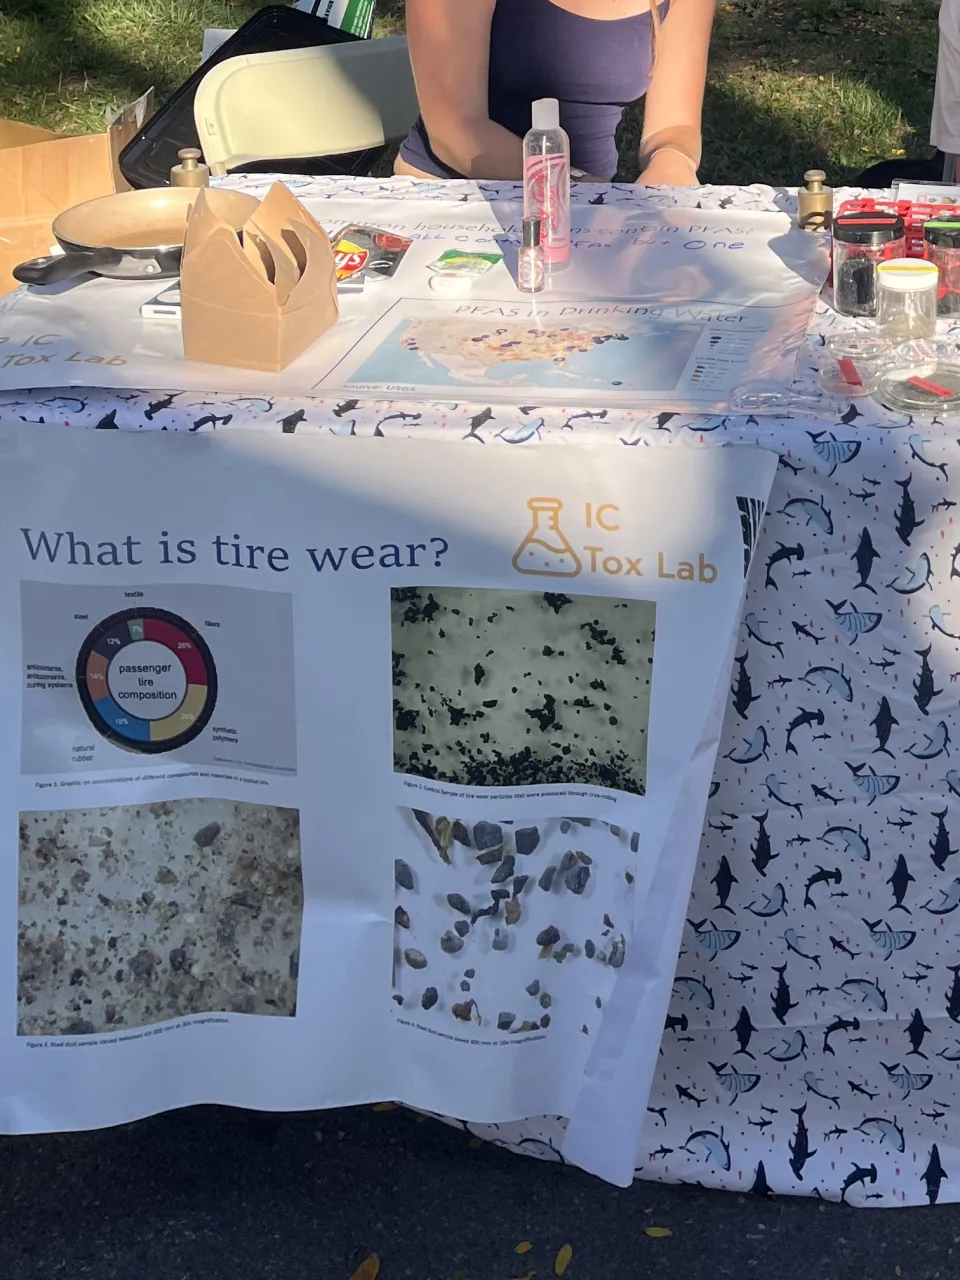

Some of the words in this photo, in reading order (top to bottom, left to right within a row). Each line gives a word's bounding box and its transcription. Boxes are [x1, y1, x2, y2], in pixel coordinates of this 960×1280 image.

[323, 0, 335, 20] AVIOR
[317, 217, 407, 233] ommon
[454, 235, 523, 246] Conta
[455, 305, 520, 317] PFAS
[527, 307, 549, 318] in
[558, 305, 664, 319] Drinking
[675, 307, 749, 322] Water
[20, 333, 62, 348] IC
[0, 352, 57, 368] Tox
[64, 351, 128, 367] Lab
[585, 502, 621, 532] IC
[19, 527, 143, 566] What
[159, 530, 197, 564] is
[213, 534, 290, 572] tire
[306, 537, 450, 572] wear?
[583, 545, 643, 577] Tox
[657, 551, 718, 584] Lab
[124, 590, 144, 598] textile
[204, 620, 221, 628] fillers
[107, 637, 121, 645] 12%
[119, 663, 172, 675] passenger
[138, 677, 154, 687] tire
[117, 690, 177, 702] composition
[212, 725, 238, 735] synthetic
[212, 734, 239, 744] polymers
[71, 743, 95, 752] natural
[71, 753, 94, 762] rubber
[35, 781, 53, 789] Figure
[92, 777, 134, 785] concentrations
[403, 780, 418, 788] Figure
[423, 785, 441, 794] Control
[567, 790, 588, 798] through
[396, 1018, 411, 1026] Figure
[26, 1041, 43, 1049] Figure
[78, 1039, 98, 1047] sample
